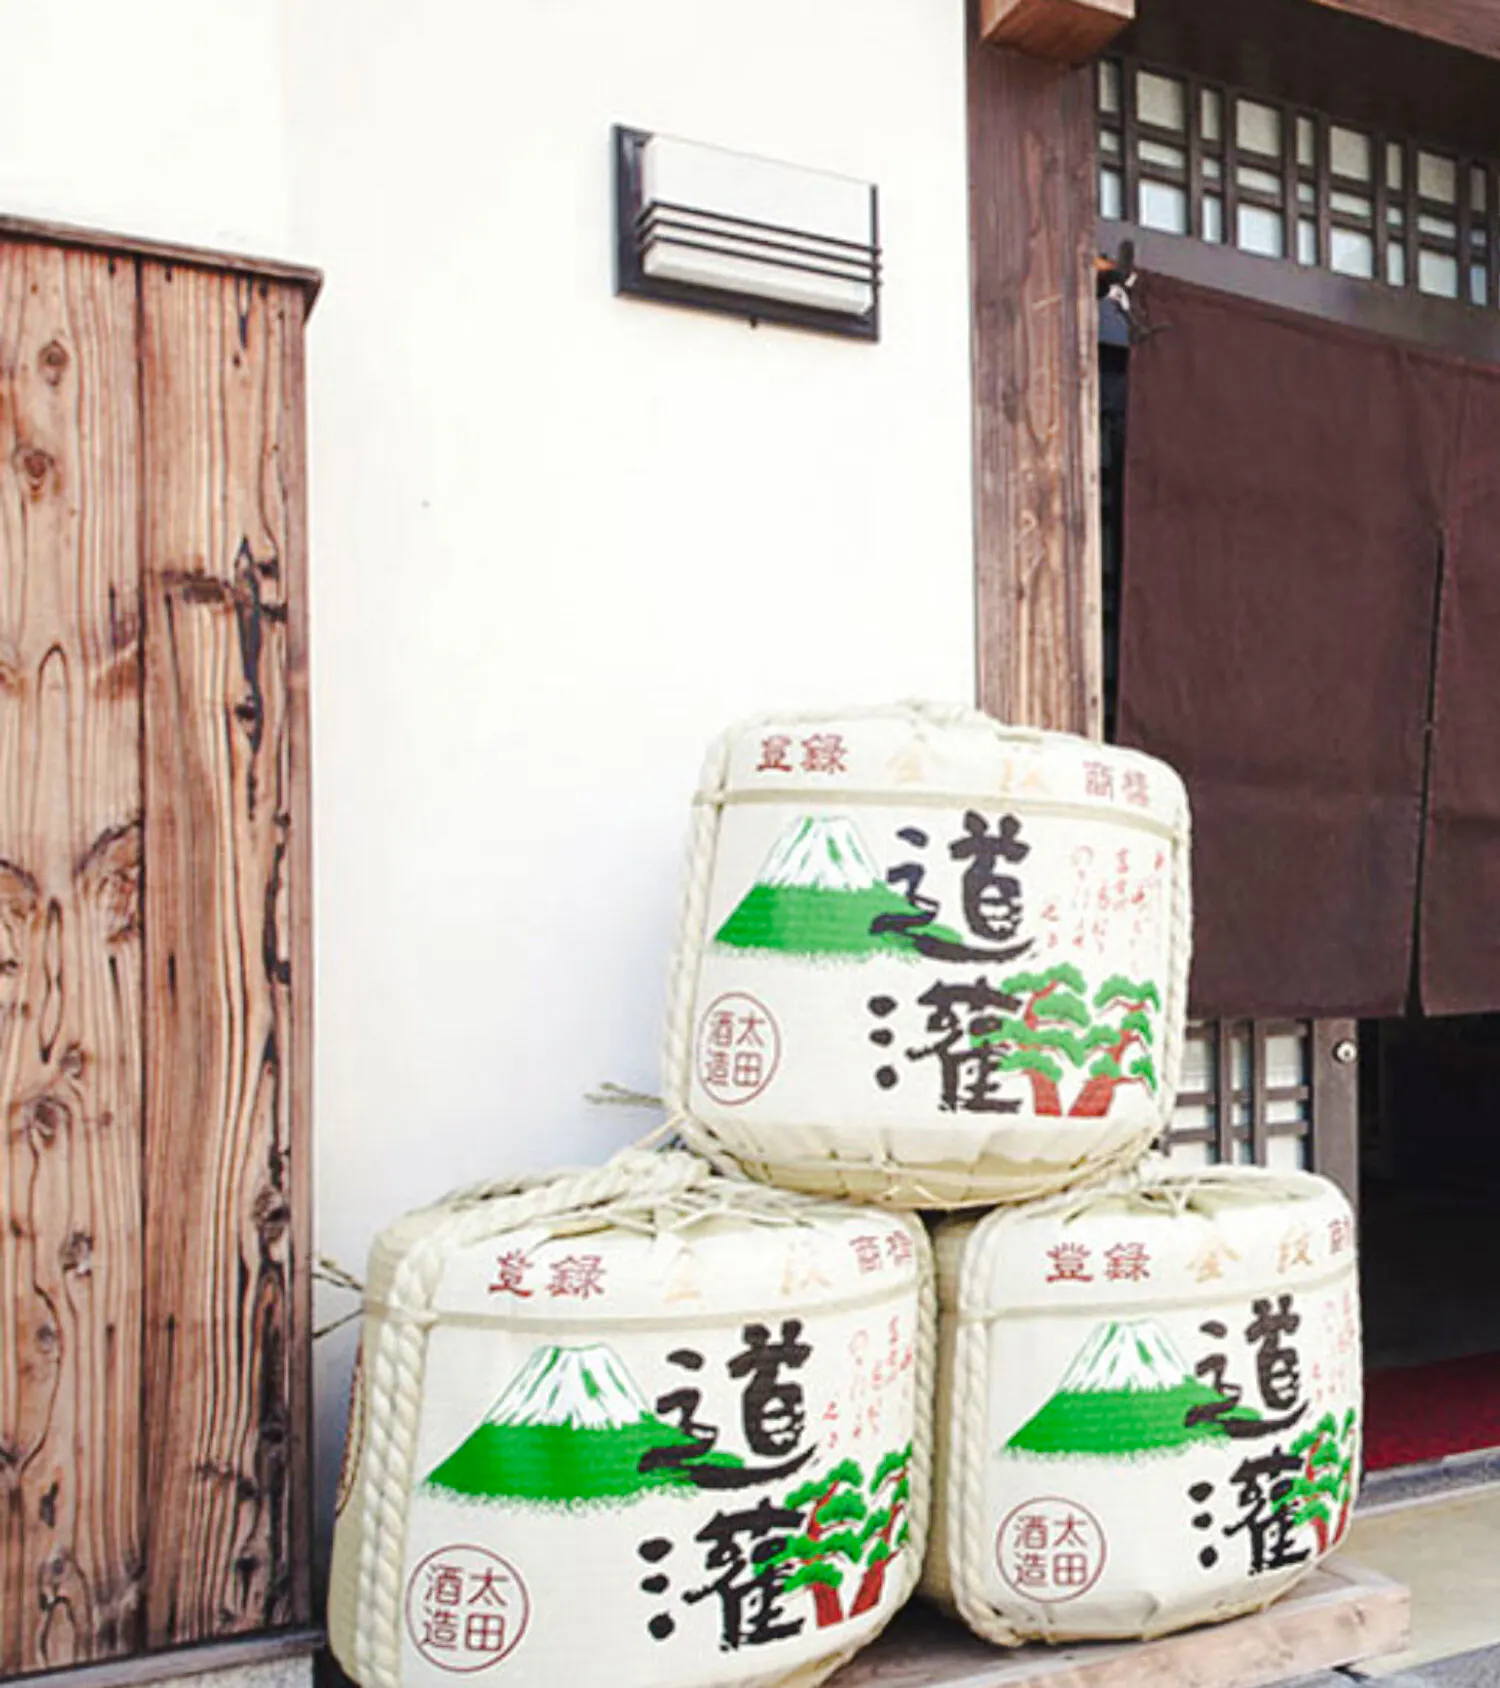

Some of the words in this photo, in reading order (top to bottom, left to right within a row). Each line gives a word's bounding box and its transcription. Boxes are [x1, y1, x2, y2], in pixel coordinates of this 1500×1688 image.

[868, 810, 1038, 1114] 道灌
[706, 1010, 735, 1087] 酒造
[732, 1011, 765, 1087] 太田
[488, 1249, 607, 1300] 登録
[1045, 1242, 1151, 1283] 登録
[1185, 1294, 1311, 1576] 道灌
[638, 1320, 817, 1652] 道灌
[1013, 1514, 1047, 1588] 酒造
[1052, 1514, 1088, 1586] 太田
[422, 1563, 462, 1652] 酒造
[464, 1567, 510, 1652] 太田
